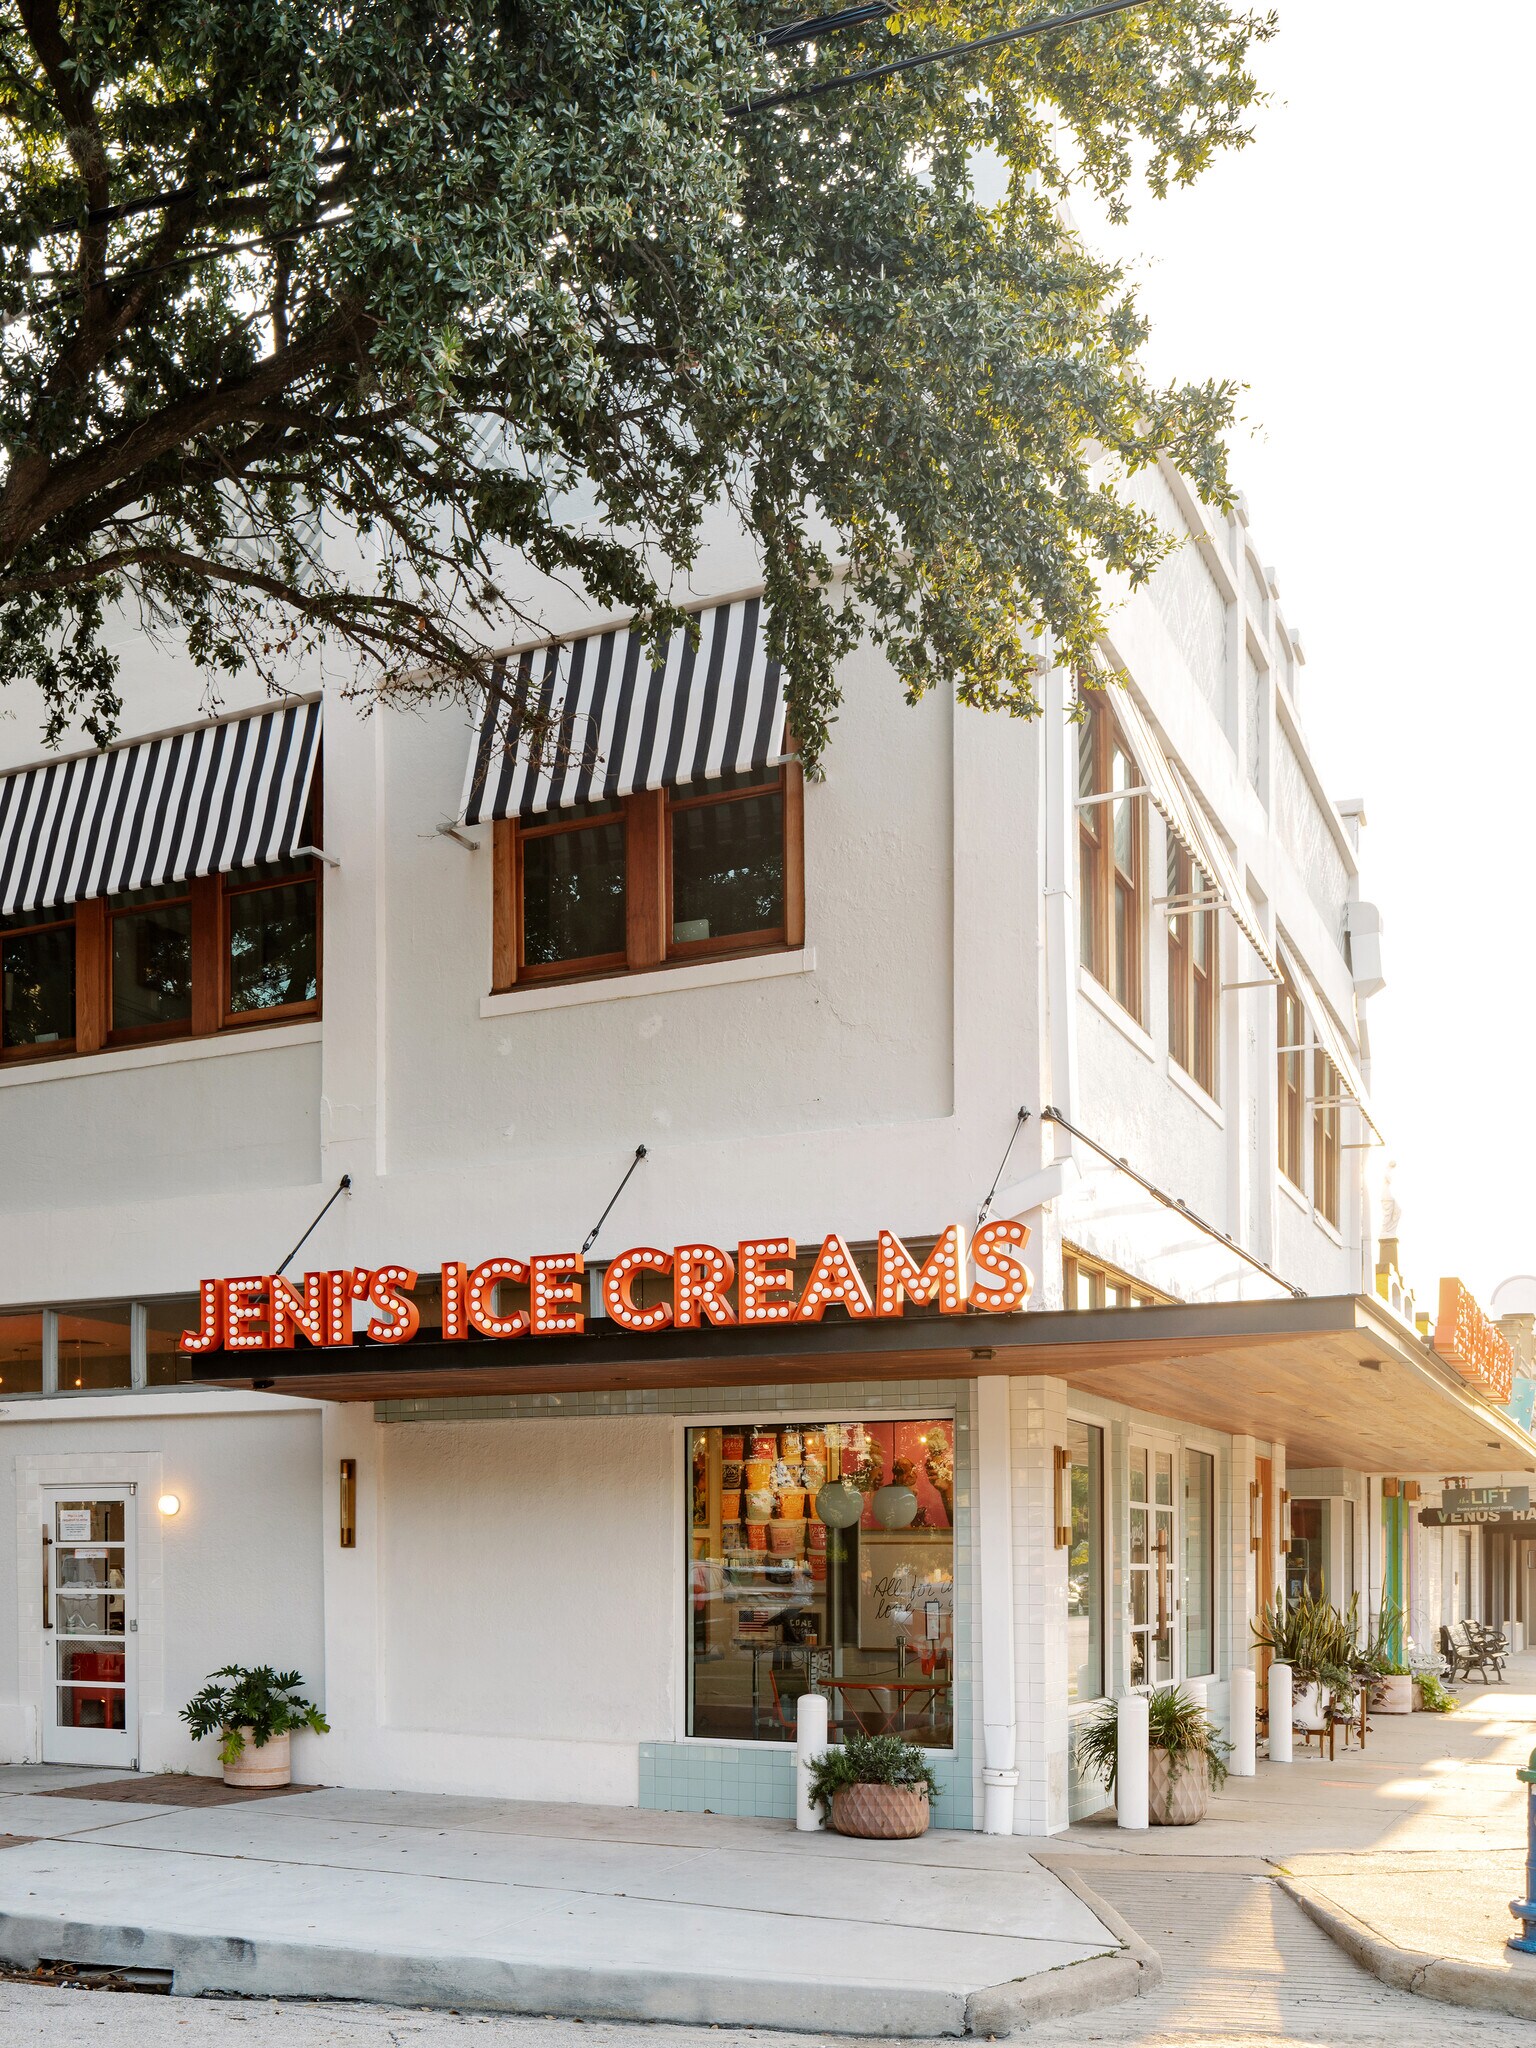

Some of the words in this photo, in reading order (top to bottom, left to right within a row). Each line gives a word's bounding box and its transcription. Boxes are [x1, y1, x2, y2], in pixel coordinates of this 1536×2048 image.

[180, 1265, 420, 1353] JENI'S
[442, 1252, 585, 1340] ICE
[603, 1220, 1035, 1332] CREAMS
[1471, 1489, 1511, 1504] LIFT
[1437, 1510, 1501, 1523] VENUS
[873, 1576, 903, 1598] All
[911, 1575, 935, 1601] for
[789, 1619, 813, 1627] CONE
